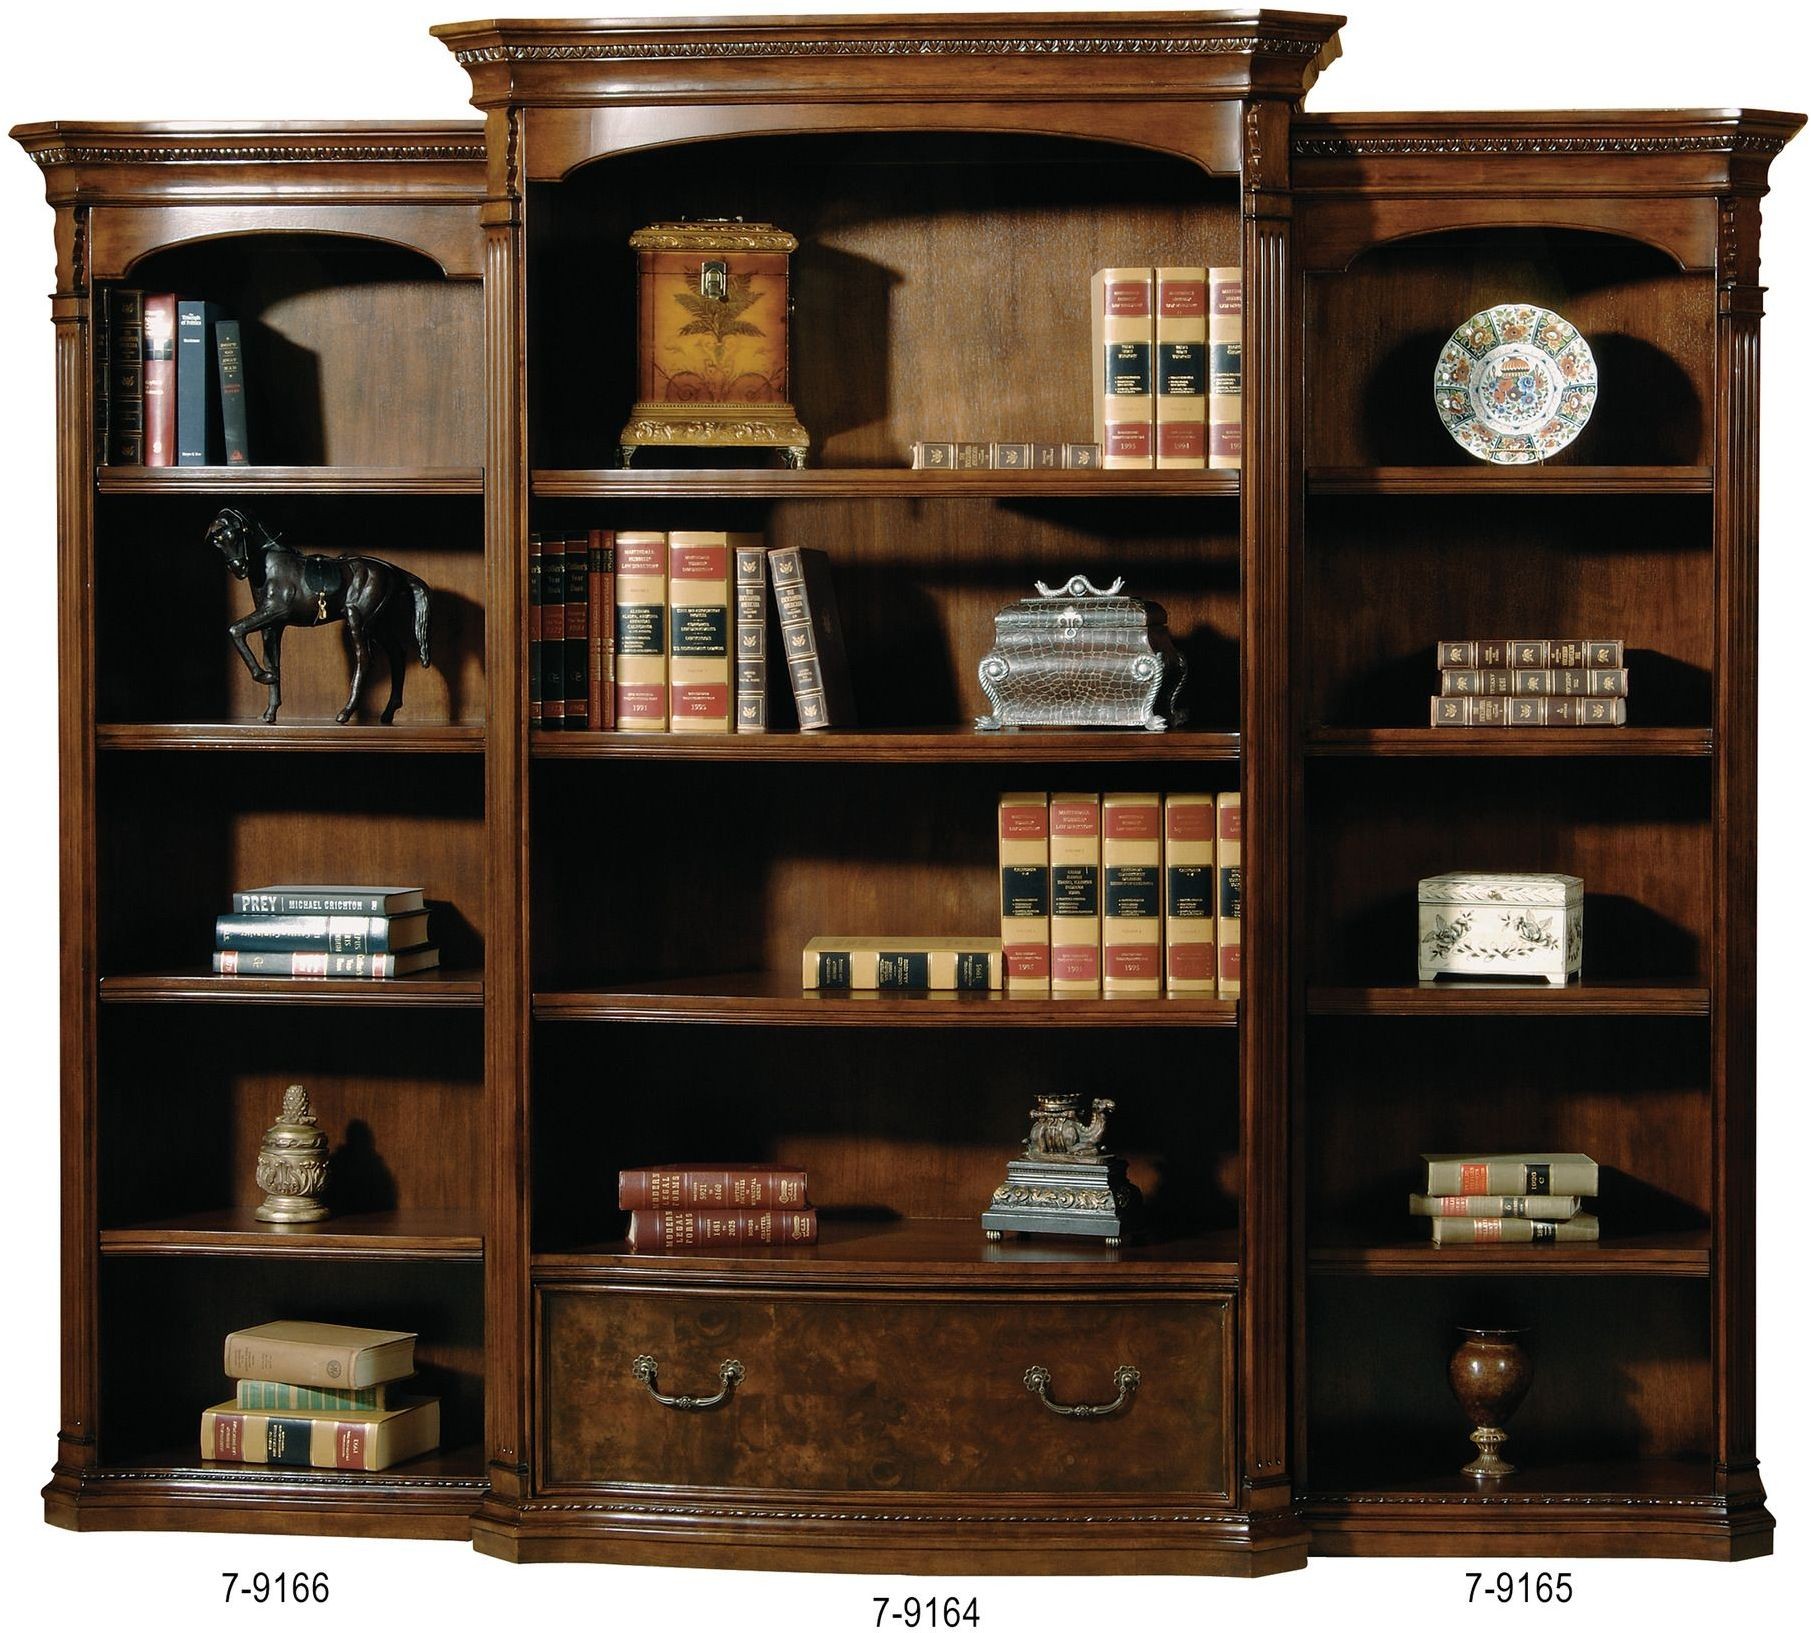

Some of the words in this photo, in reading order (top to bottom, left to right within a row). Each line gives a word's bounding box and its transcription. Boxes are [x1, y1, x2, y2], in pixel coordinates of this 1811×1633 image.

[242, 896, 277, 912] PREY
[289, 900, 322, 910] MICHAEL
[324, 901, 362, 910] CRICHTON
[652, 1173, 660, 1209] MODERN
[672, 1176, 680, 1206] FORMS
[685, 1213, 693, 1244] FORMS
